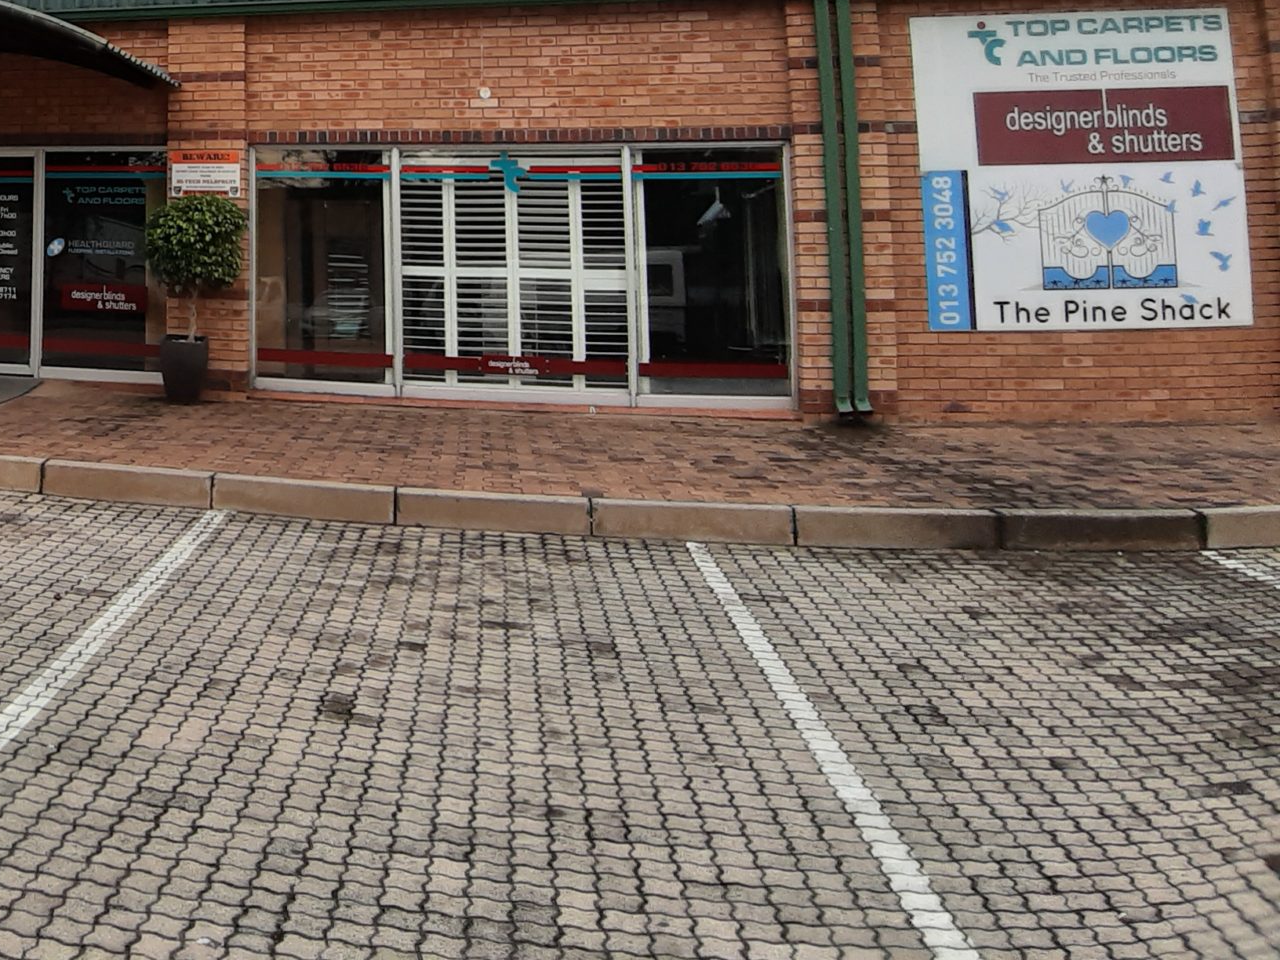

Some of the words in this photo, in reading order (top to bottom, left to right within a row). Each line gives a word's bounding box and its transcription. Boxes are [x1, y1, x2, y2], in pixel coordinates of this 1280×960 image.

[1006, 19, 1070, 37] TOP
[1077, 15, 1223, 36] CARPETS
[1016, 48, 1088, 67] AND
[1094, 45, 1219, 66] FLOORS
[1028, 71, 1050, 83] The
[1052, 71, 1097, 82] Trusted
[1100, 69, 1177, 81] Professionals
[1006, 106, 1101, 136] designer
[1087, 132, 1106, 154] &
[1111, 130, 1203, 153] shutters
[930, 175, 954, 231] 3048
[935, 236, 957, 278] 752
[104, 300, 137, 310] shutters
[938, 282, 961, 326] 013
[993, 300, 1051, 324] The
[1064, 299, 1128, 323] Pine
[1140, 297, 1232, 322] Shack
